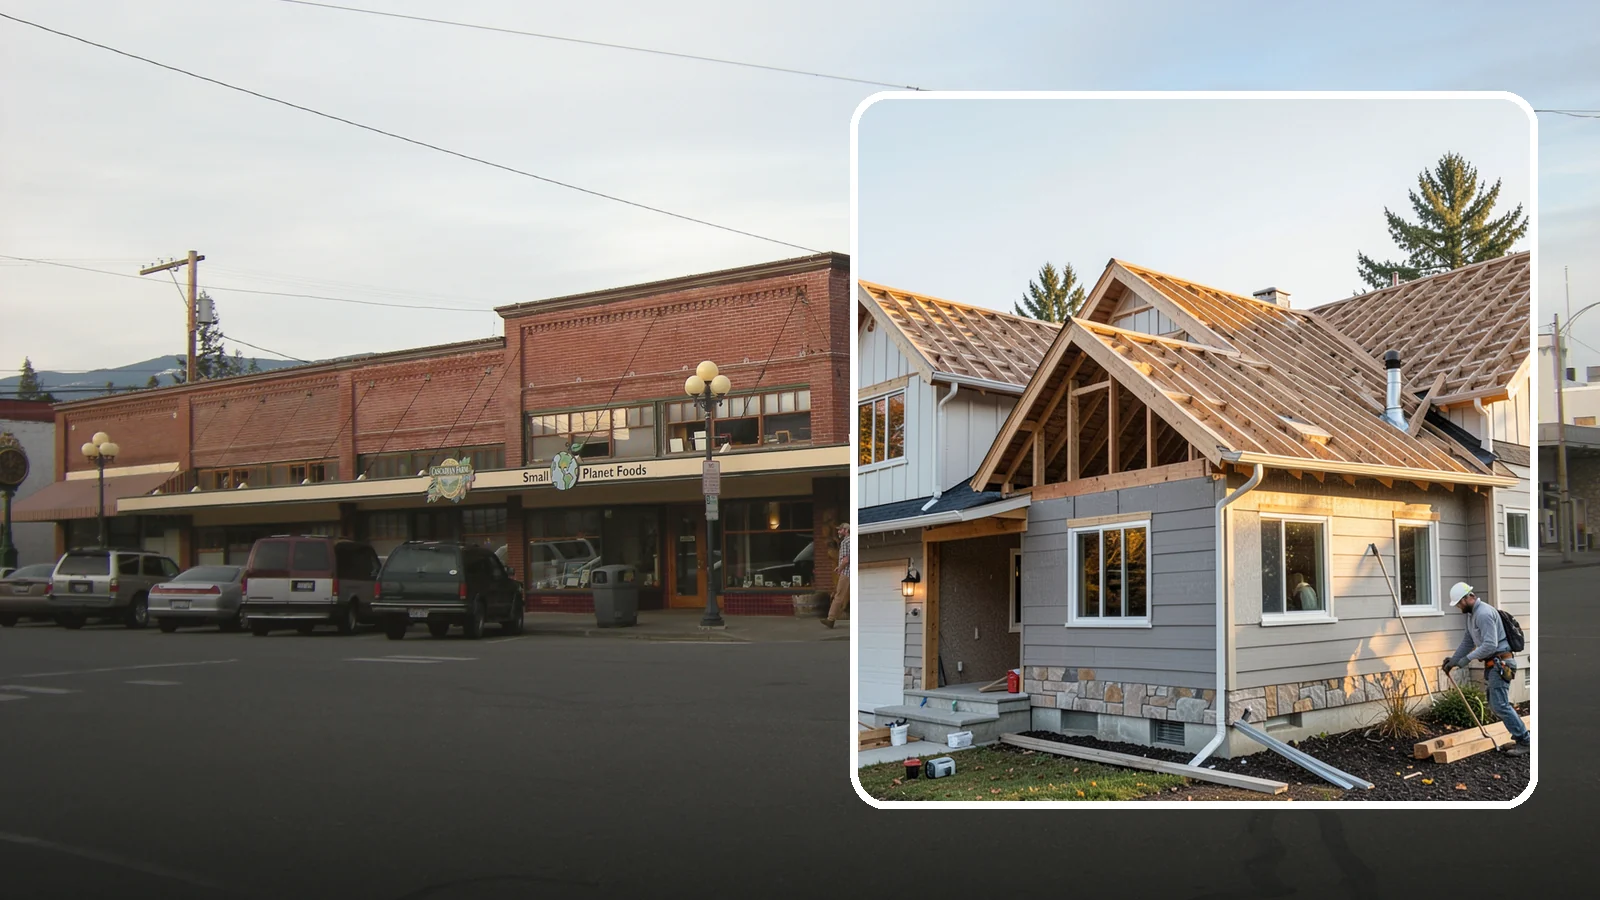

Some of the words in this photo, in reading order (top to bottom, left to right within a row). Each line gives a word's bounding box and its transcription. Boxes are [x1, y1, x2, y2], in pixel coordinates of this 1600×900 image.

[523, 470, 549, 483] Small
[583, 467, 614, 479] Planet
[617, 464, 647, 477] Foods
